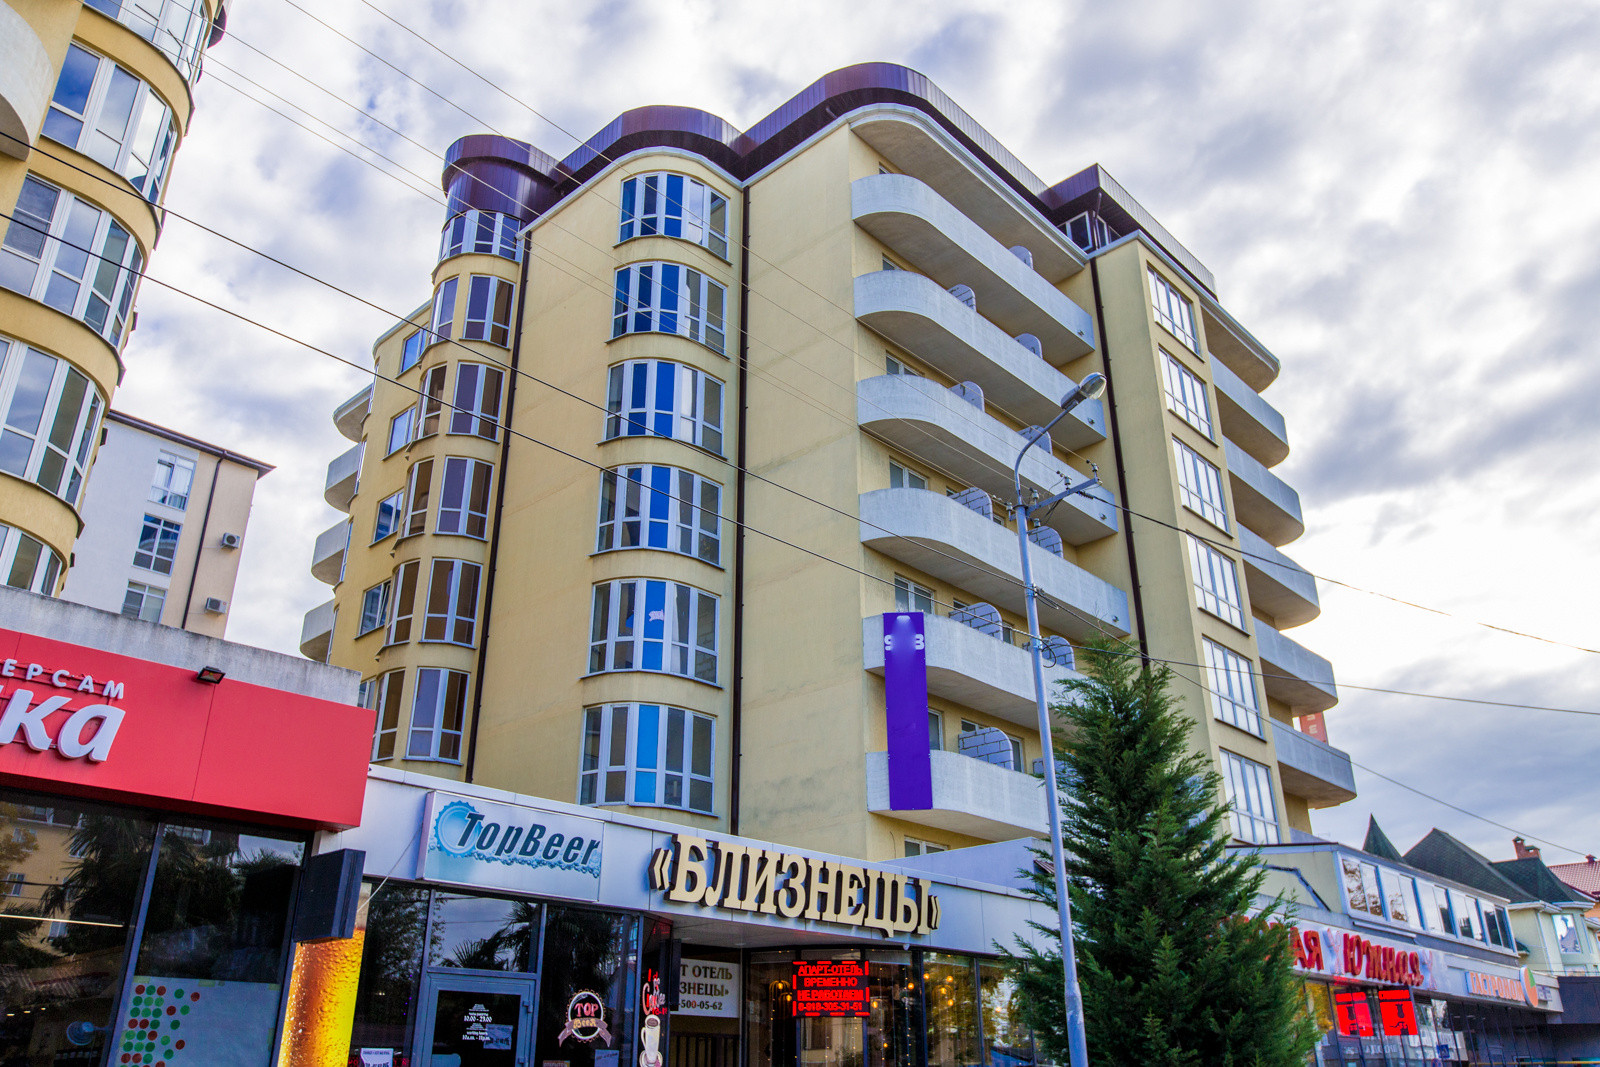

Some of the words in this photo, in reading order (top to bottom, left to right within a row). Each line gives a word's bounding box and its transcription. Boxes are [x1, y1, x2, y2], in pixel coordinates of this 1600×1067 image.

[0, 684, 126, 762] ка
[457, 811, 601, 866] TopBeer
[648, 833, 941, 938] «БЛИЗНЕЦЫ»
[692, 965, 733, 980] ОТЕЛЬ
[798, 965, 863, 976] АПАРТ-ОТЕЛЬ
[804, 977, 858, 987] ВРЕМЕННО
[797, 989, 811, 1001] НЕ
[574, 1002, 599, 1017] TOP
